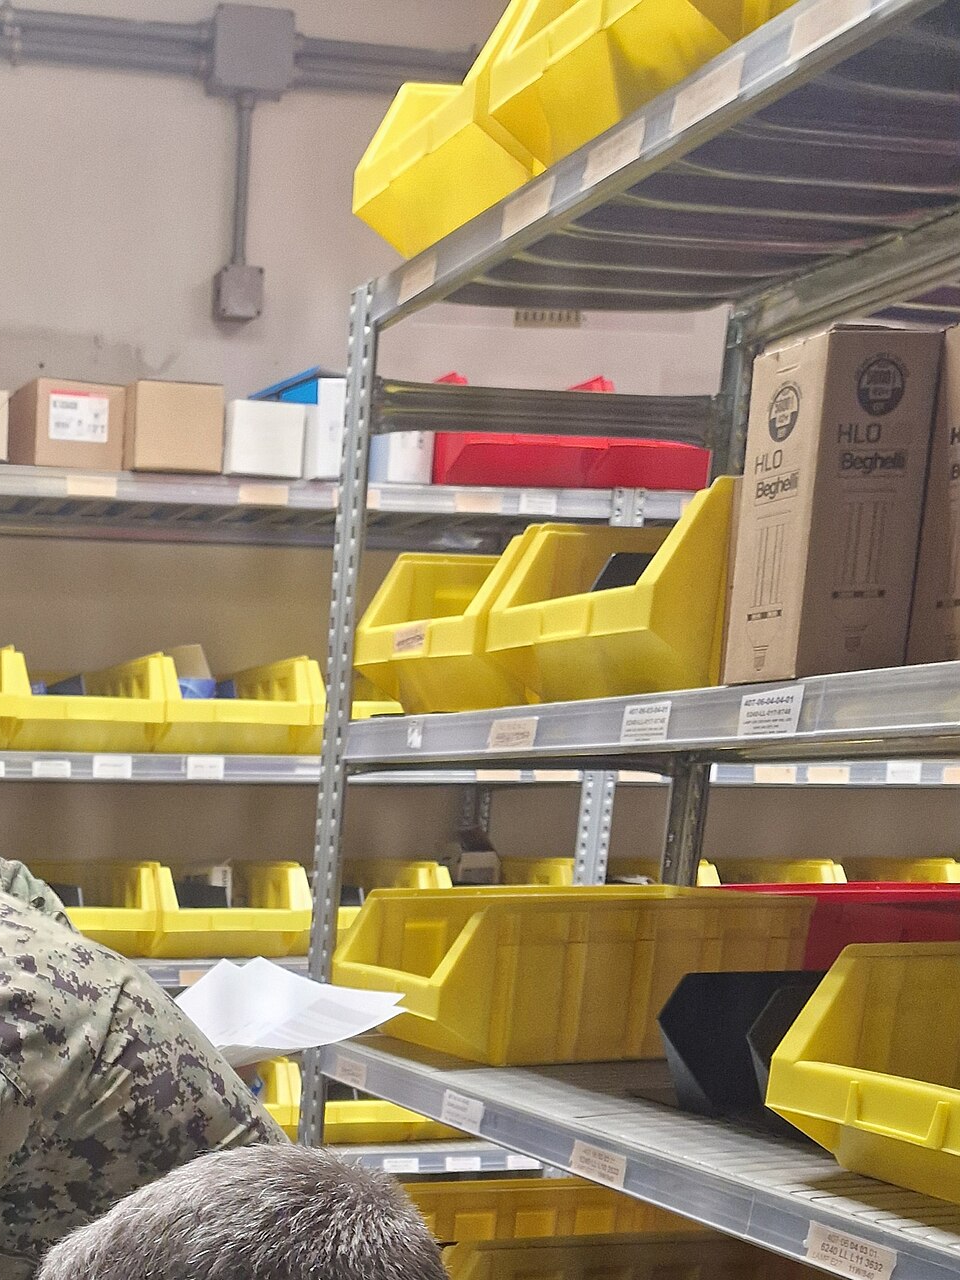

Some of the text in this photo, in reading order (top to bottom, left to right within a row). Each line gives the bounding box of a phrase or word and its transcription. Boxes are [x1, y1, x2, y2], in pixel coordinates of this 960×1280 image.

[837, 423, 882, 444] HLO
[754, 449, 783, 475] HLO
[841, 452, 907, 474] Beghelli
[755, 471, 800, 500] Beghelli
[839, 1249, 848, 1260] LL
